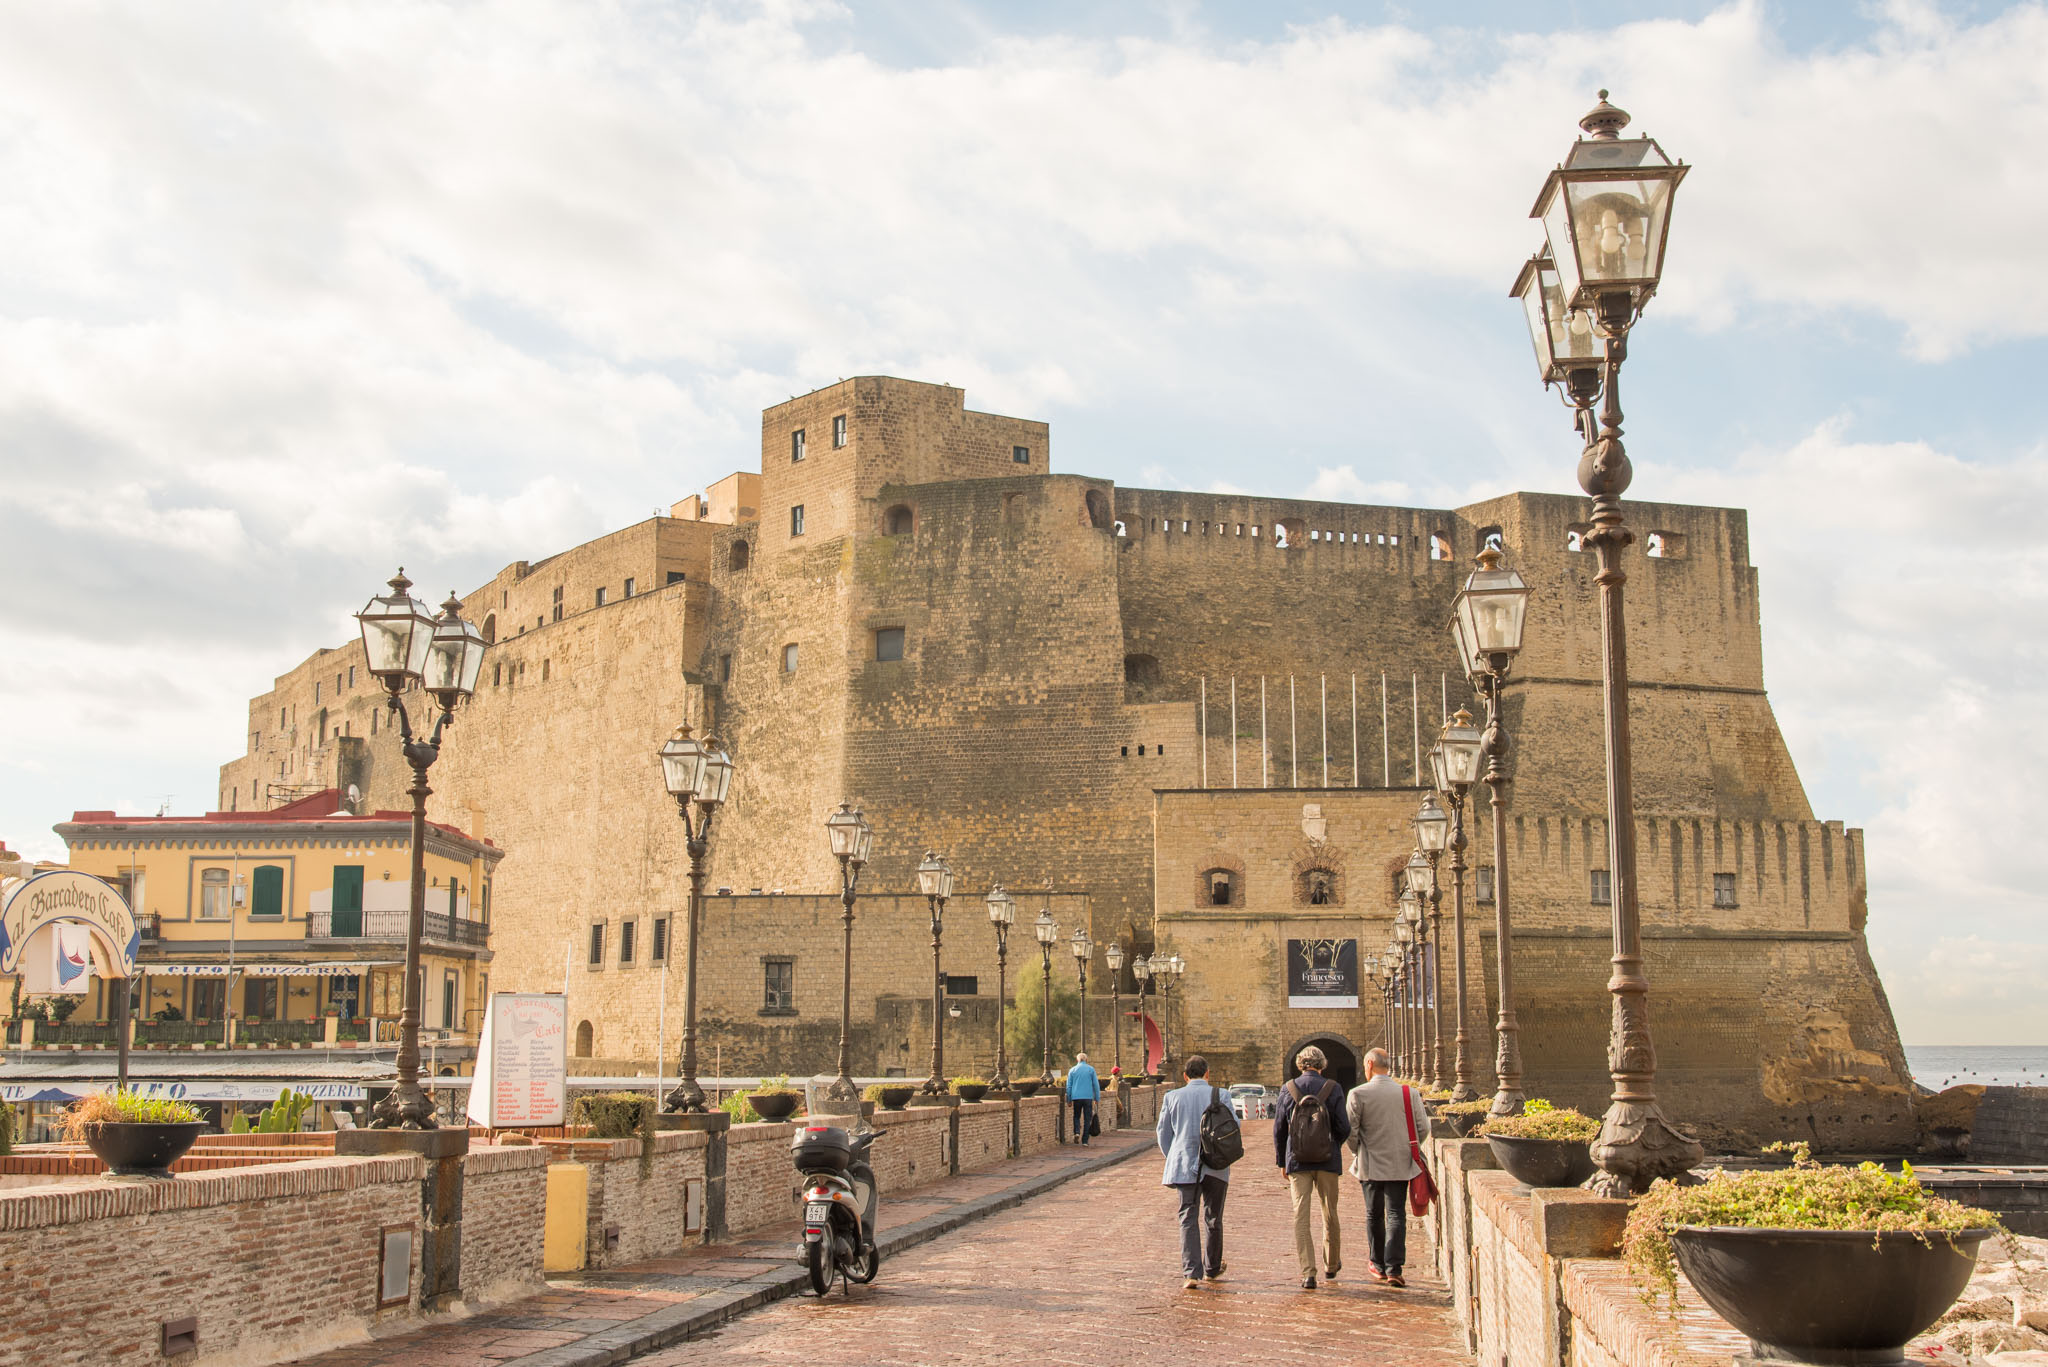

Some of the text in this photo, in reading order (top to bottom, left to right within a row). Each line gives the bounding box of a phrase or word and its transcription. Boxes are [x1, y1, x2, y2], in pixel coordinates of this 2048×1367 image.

[12, 904, 26, 946] al
[30, 880, 96, 922] Barcadero
[1302, 972, 1344, 982] Francesco
[295, 1085, 362, 1097] PIZZERIA
